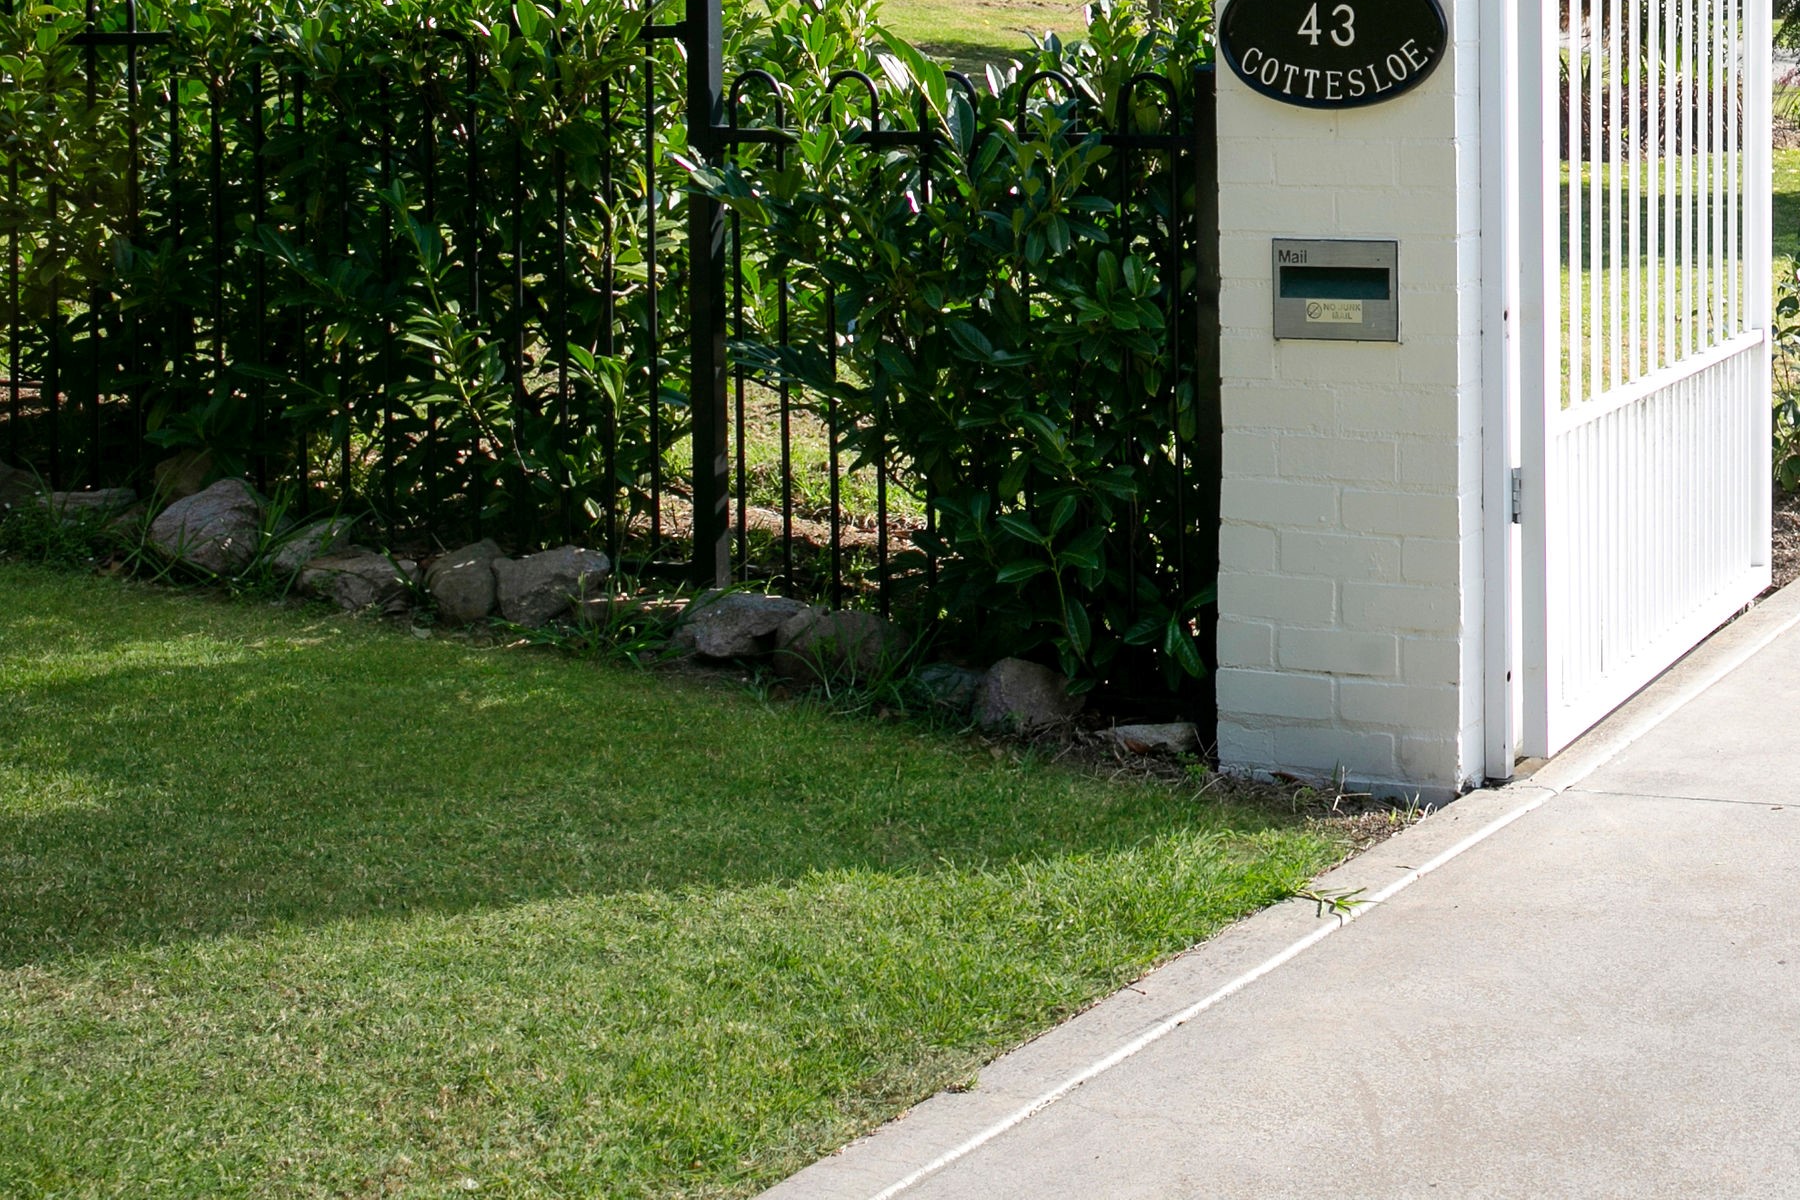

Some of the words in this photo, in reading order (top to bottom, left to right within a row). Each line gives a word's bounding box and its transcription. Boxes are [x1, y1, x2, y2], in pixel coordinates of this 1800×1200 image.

[1297, 2, 1356, 47] 43
[1241, 38, 1429, 100] COTTESLOE
[1278, 250, 1308, 263] Mail
[1323, 303, 1336, 311] NO
